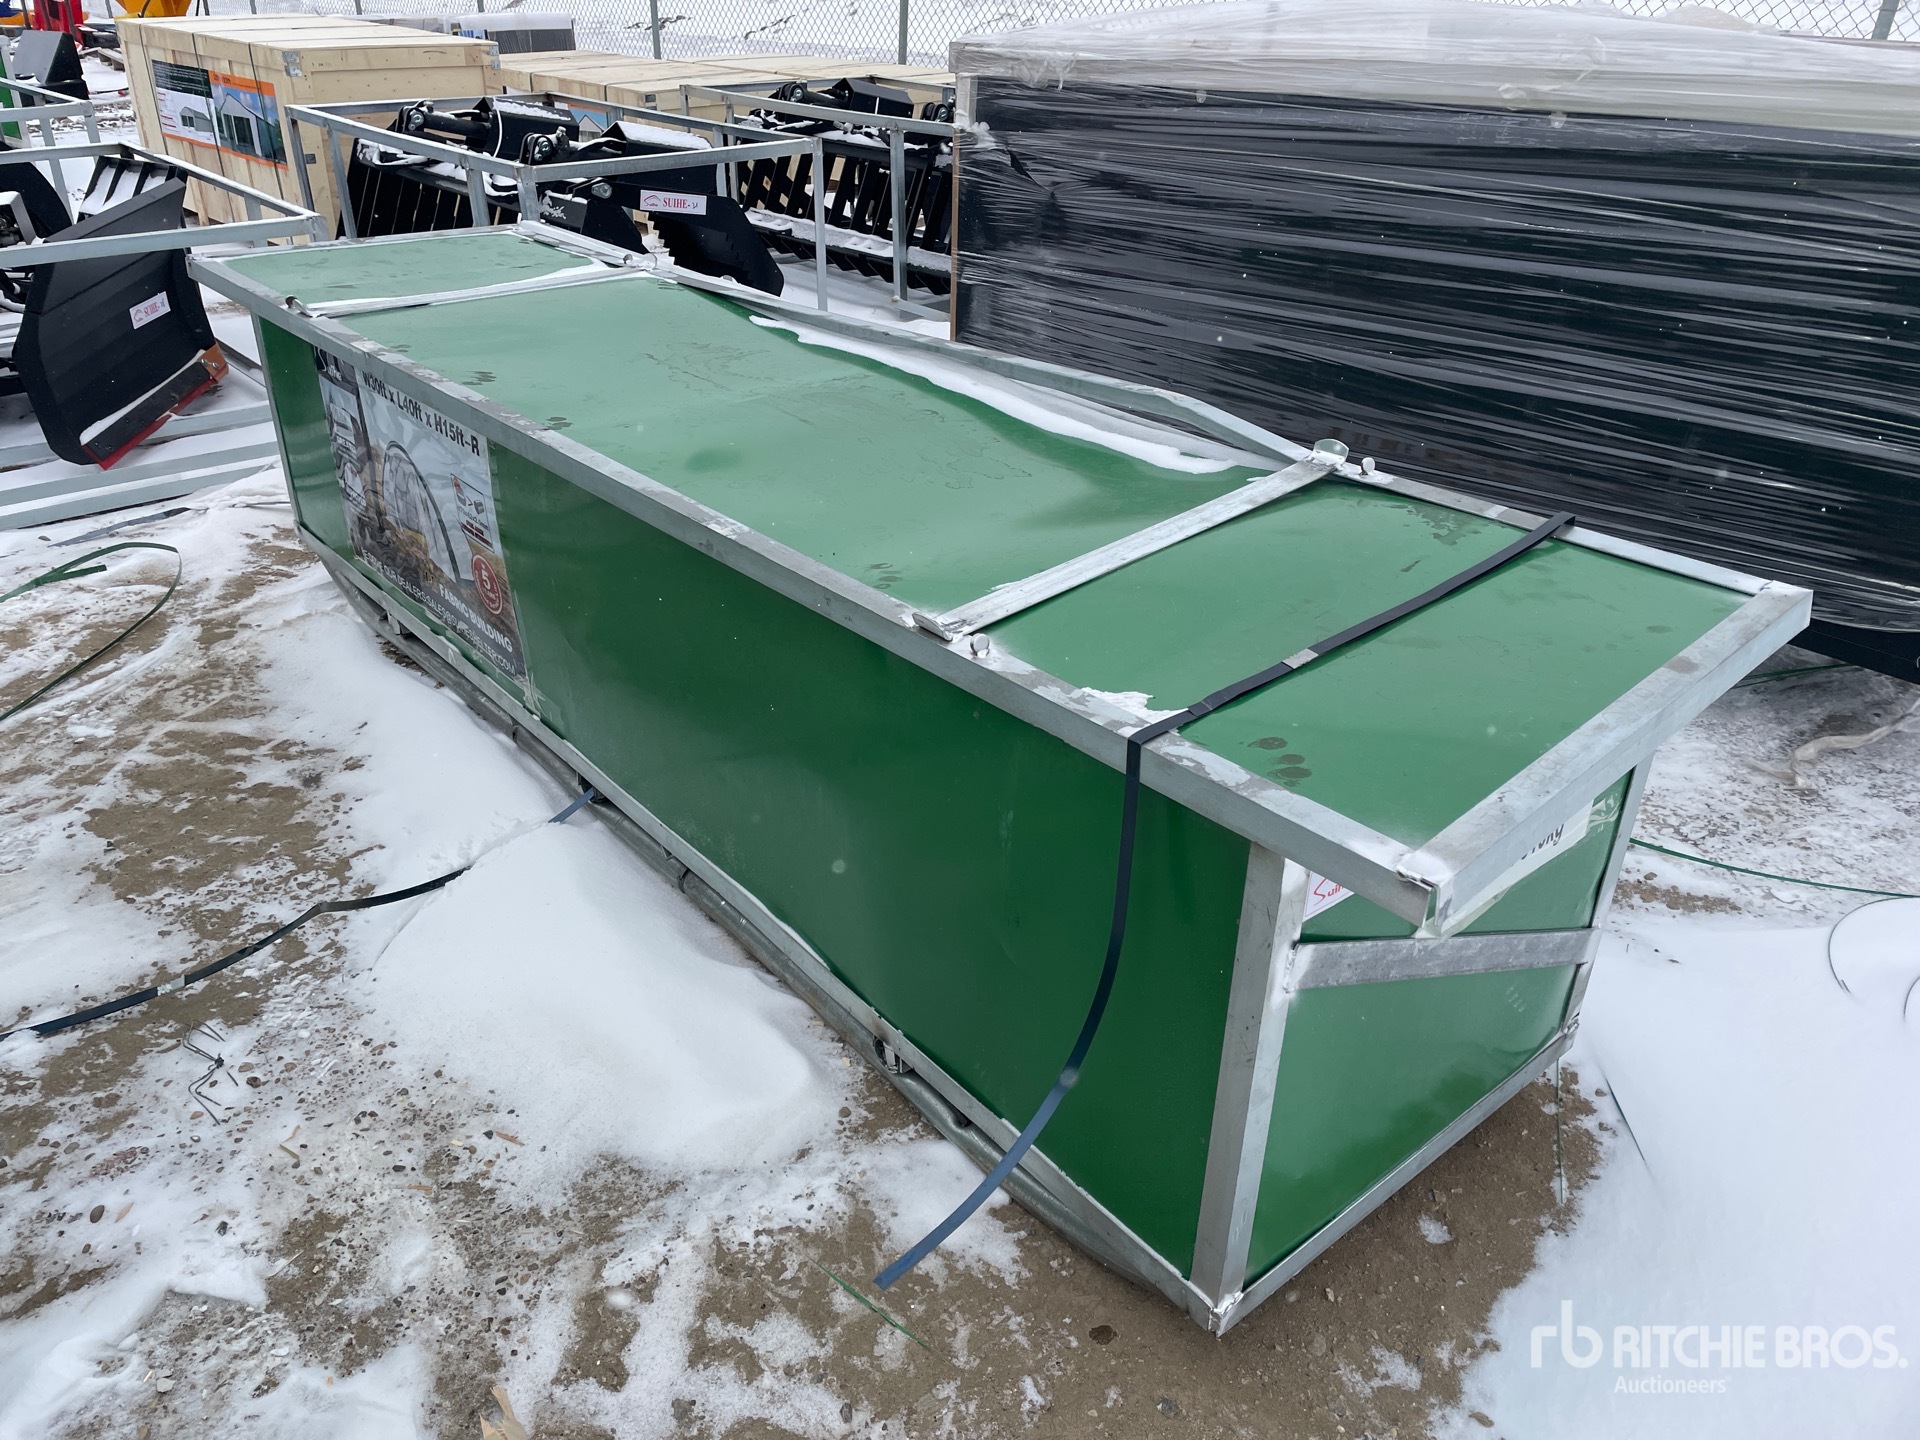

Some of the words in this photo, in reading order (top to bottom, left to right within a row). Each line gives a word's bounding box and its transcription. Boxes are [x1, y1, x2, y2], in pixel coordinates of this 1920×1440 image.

[362, 371, 388, 399] W30ft
[389, 390, 396, 404] x
[397, 391, 423, 422] L40ft
[425, 412, 432, 428] x
[434, 412, 480, 457] H15ft-R
[482, 569, 491, 590] 5
[439, 583, 469, 618] FABRIC
[469, 608, 513, 653] BUILDING
